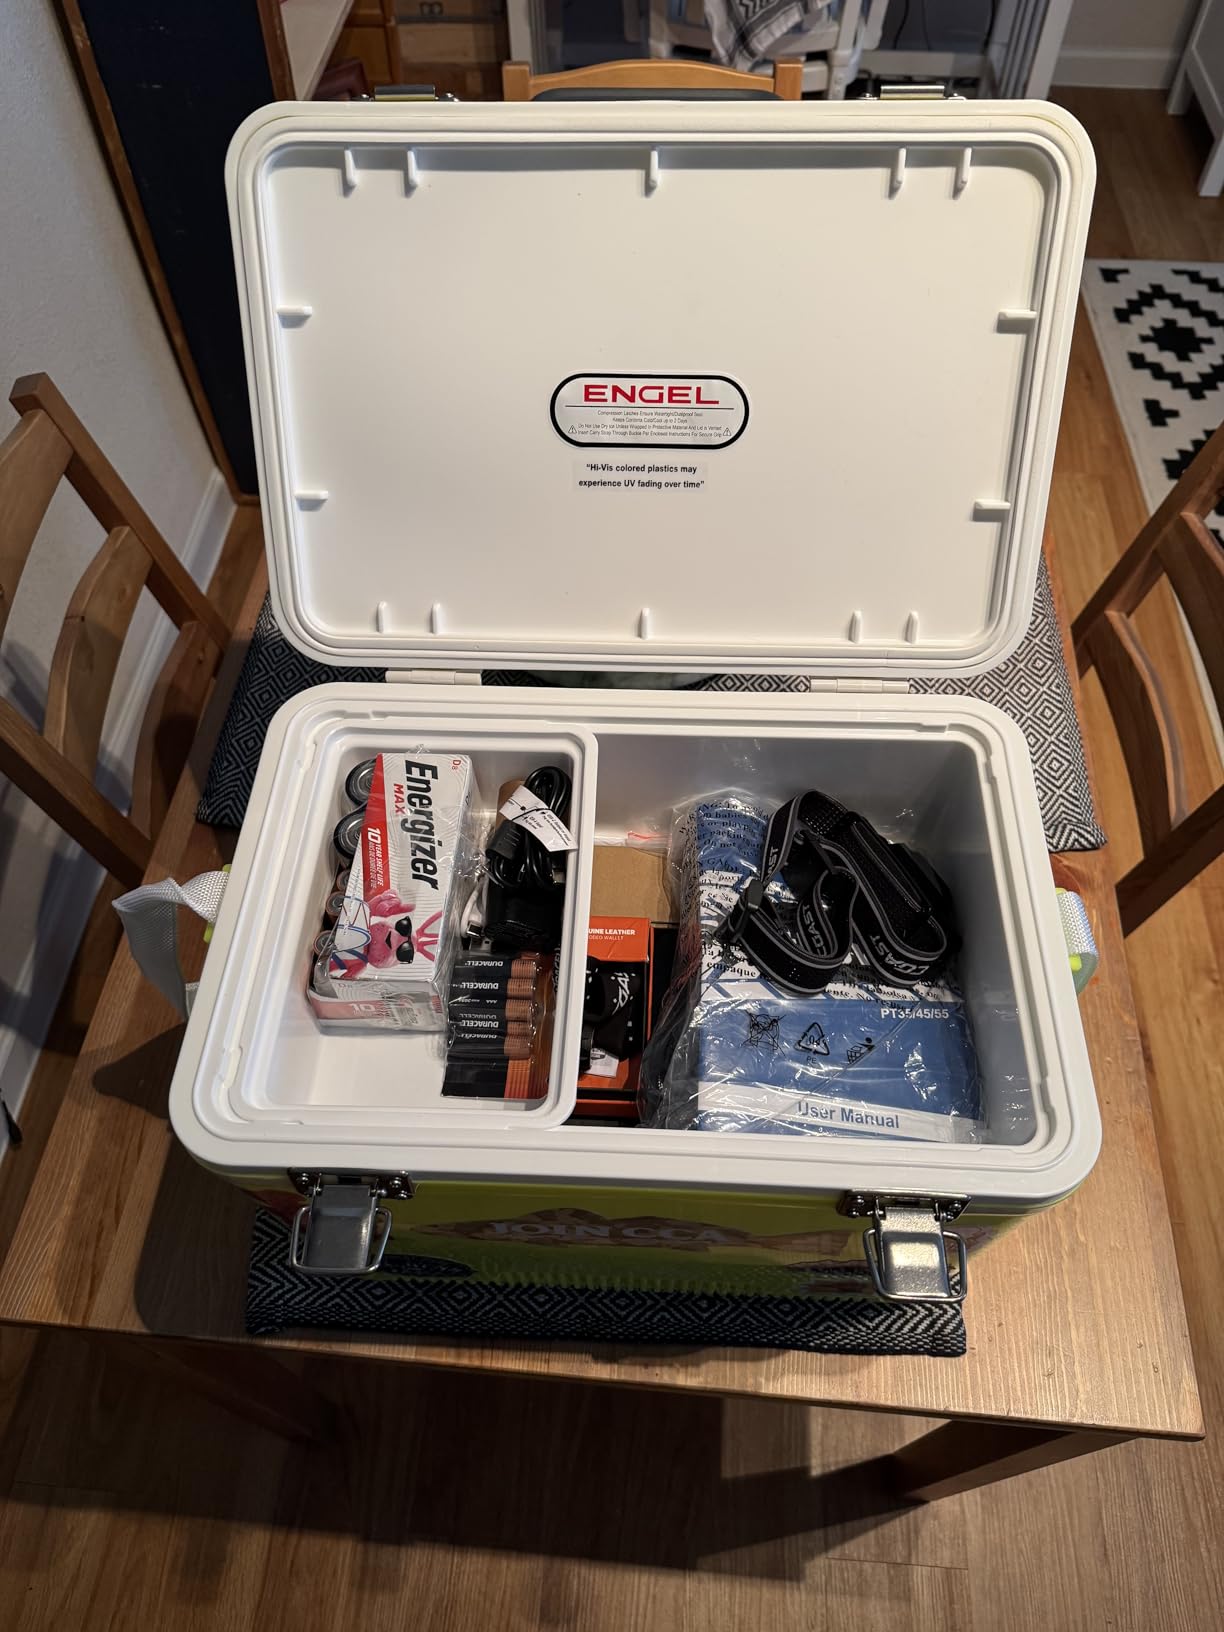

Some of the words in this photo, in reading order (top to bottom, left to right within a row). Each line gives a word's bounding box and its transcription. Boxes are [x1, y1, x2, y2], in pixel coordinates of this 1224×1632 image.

[584, 384, 720, 404] ENGEL
[616, 464, 645, 472] colored
[648, 464, 678, 474] plastics
[578, 480, 622, 488] experience
[638, 480, 662, 490] fading
[394, 783, 406, 814] MAX
[400, 760, 442, 890] Energizer
[368, 828, 381, 844] 10
[870, 934, 930, 975] COAST
[706, 961, 757, 978] empaque
[880, 1008, 950, 1020] PT35/45/55
[462, 1020, 499, 1028] DURACELL
[797, 1102, 836, 1120] User
[840, 1106, 900, 1128] Manual
[490, 1222, 609, 1238] JOIN
[622, 1226, 730, 1243] CCA
